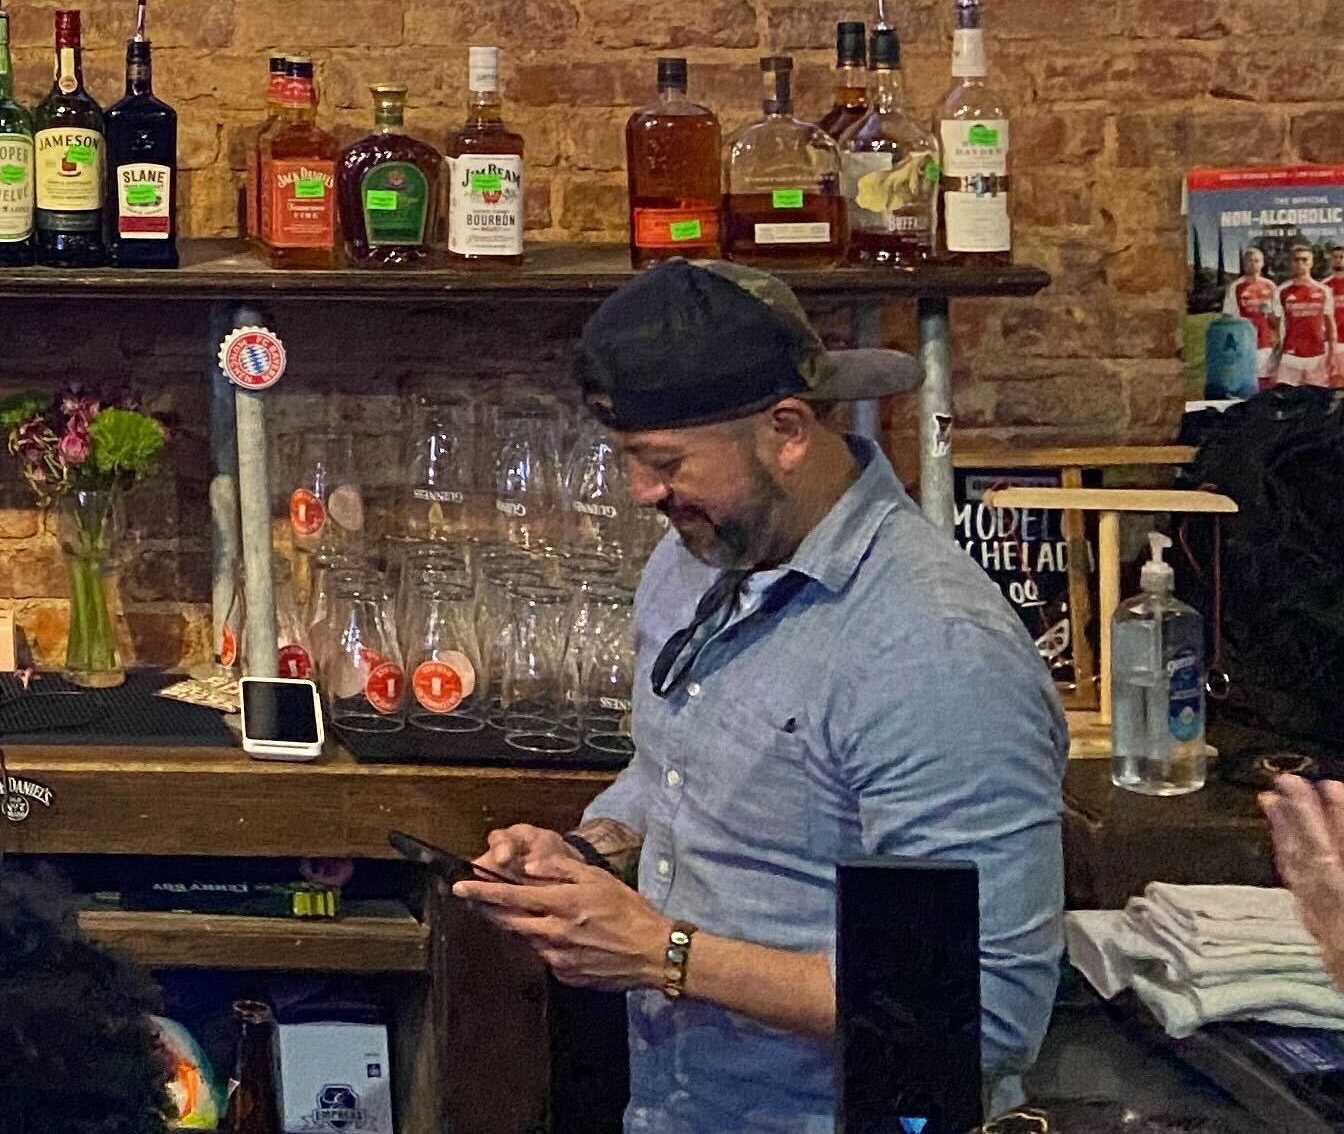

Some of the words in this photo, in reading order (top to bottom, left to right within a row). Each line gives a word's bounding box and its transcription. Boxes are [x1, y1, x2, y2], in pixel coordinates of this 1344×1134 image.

[38, 134, 99, 151] JAMESON
[123, 170, 166, 183] SLANE
[466, 214, 515, 226] BOURBON
[1221, 207, 1343, 227] NON-ALCOHOLIC
[954, 502, 1069, 542] MODEL
[8, 776, 53, 806] DANIEL'S
